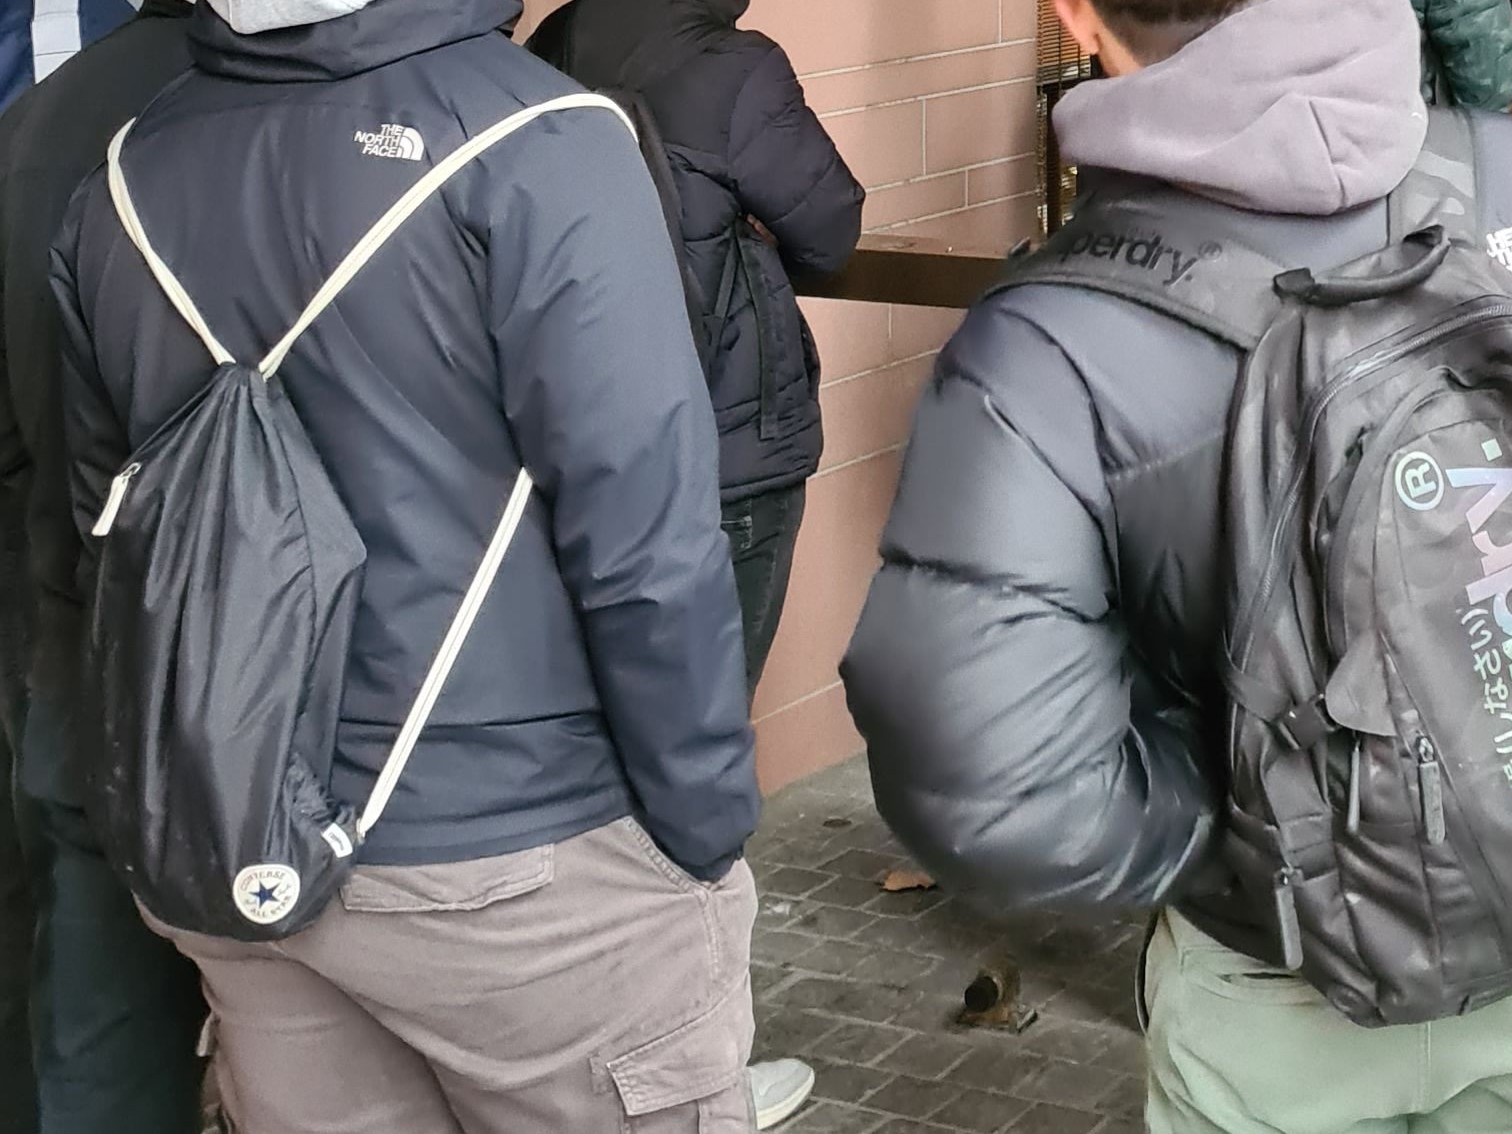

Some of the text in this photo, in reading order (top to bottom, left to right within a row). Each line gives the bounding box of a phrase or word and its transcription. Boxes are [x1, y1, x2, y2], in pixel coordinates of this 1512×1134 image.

[381, 123, 405, 136] THE
[354, 130, 402, 147] NORTH
[362, 143, 399, 157] FACE
